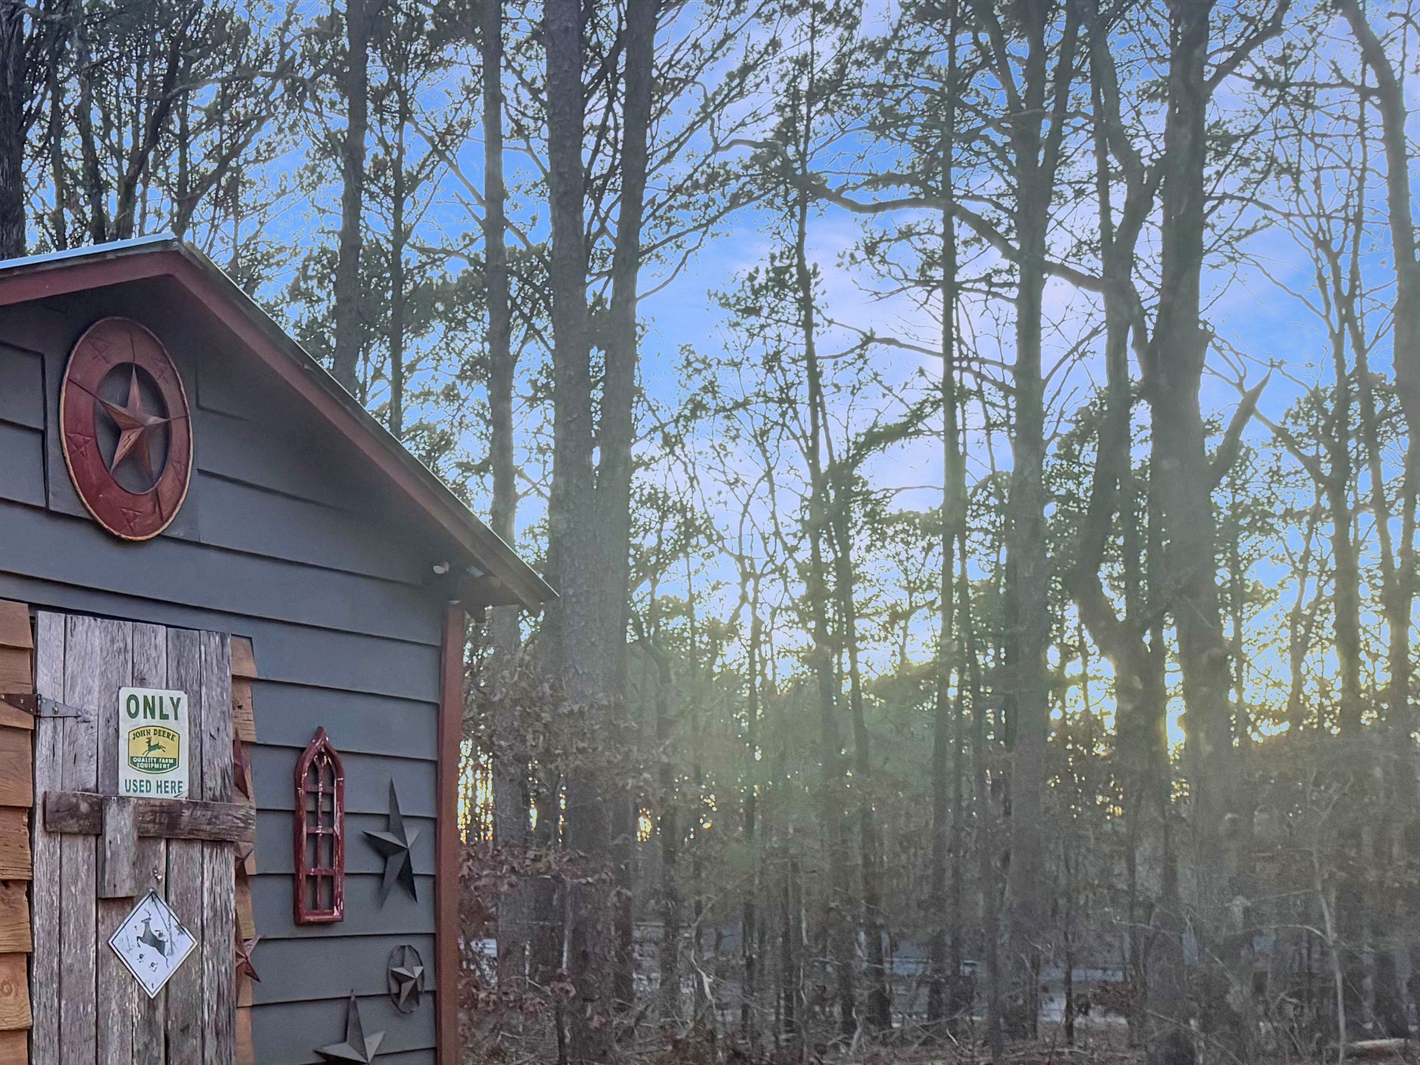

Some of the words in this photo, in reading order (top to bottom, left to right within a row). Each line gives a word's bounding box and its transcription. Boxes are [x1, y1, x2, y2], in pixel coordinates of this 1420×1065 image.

[126, 694, 181, 721] ONLY
[132, 728, 151, 740] JOHN
[153, 728, 176, 742] DEERE
[124, 779, 152, 793] USED
[156, 780, 183, 794] HERE
